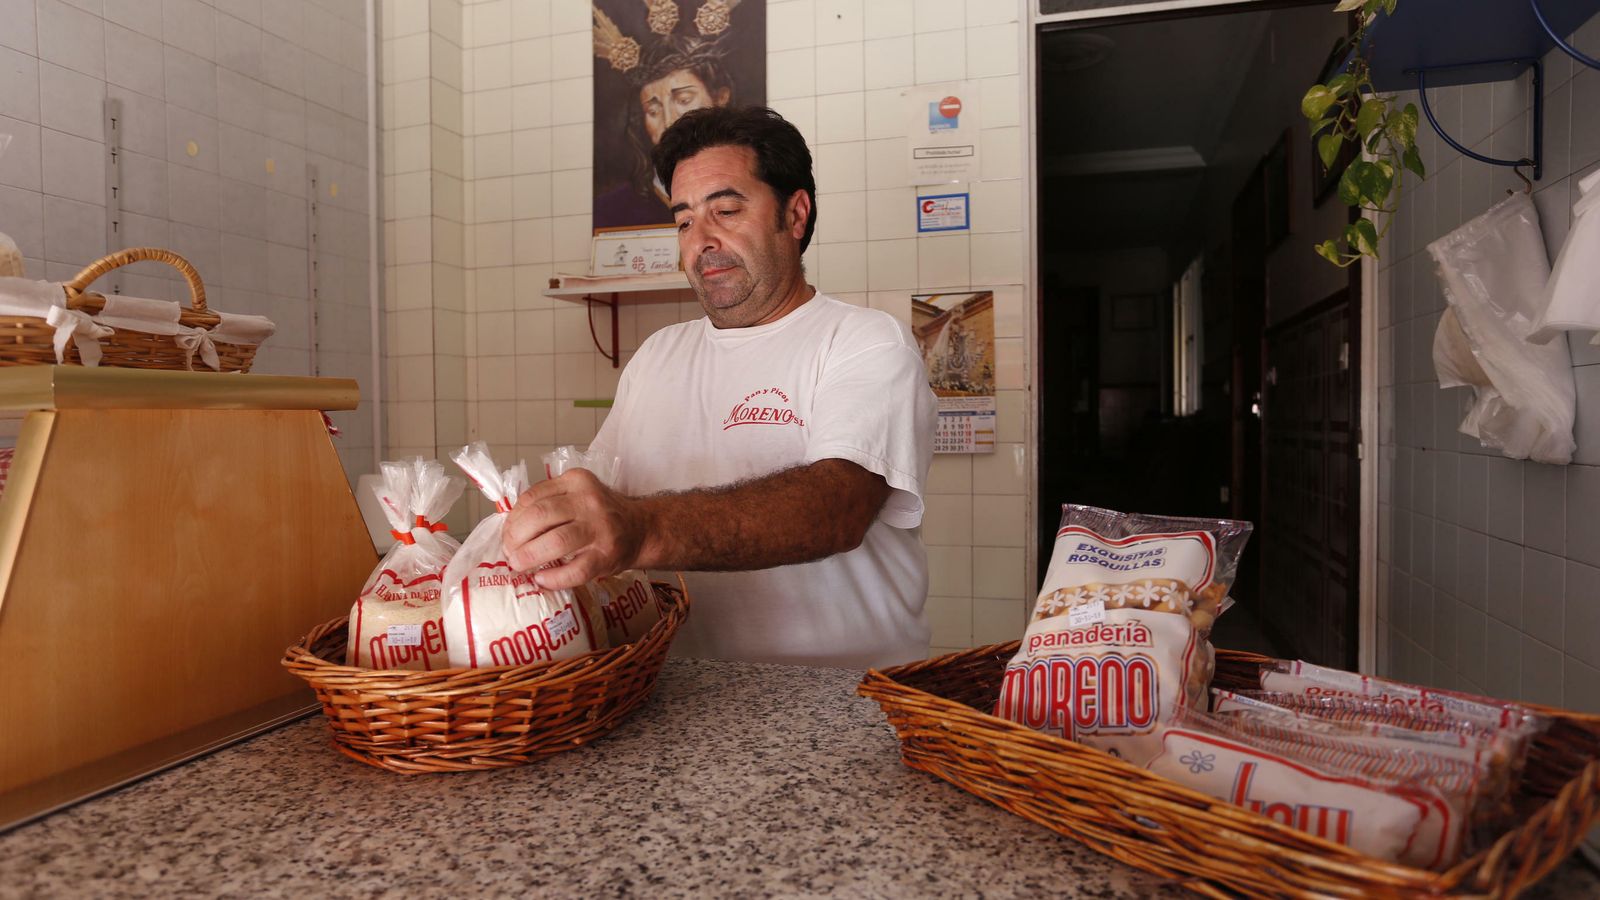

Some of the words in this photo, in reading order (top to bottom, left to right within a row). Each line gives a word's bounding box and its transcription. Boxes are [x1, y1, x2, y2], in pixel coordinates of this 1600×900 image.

[744, 390, 761, 402] Pan
[770, 387, 789, 403] Picos
[723, 402, 793, 424] MORENO
[1077, 543, 1164, 562] EXQUISITAS
[1067, 554, 1162, 571] ROSQUILLAS
[479, 574, 512, 587] HARIN
[376, 584, 408, 602] HARINA
[369, 617, 448, 671] MORE
[1029, 621, 1149, 649] panadería
[992, 656, 1155, 742] MORENO
